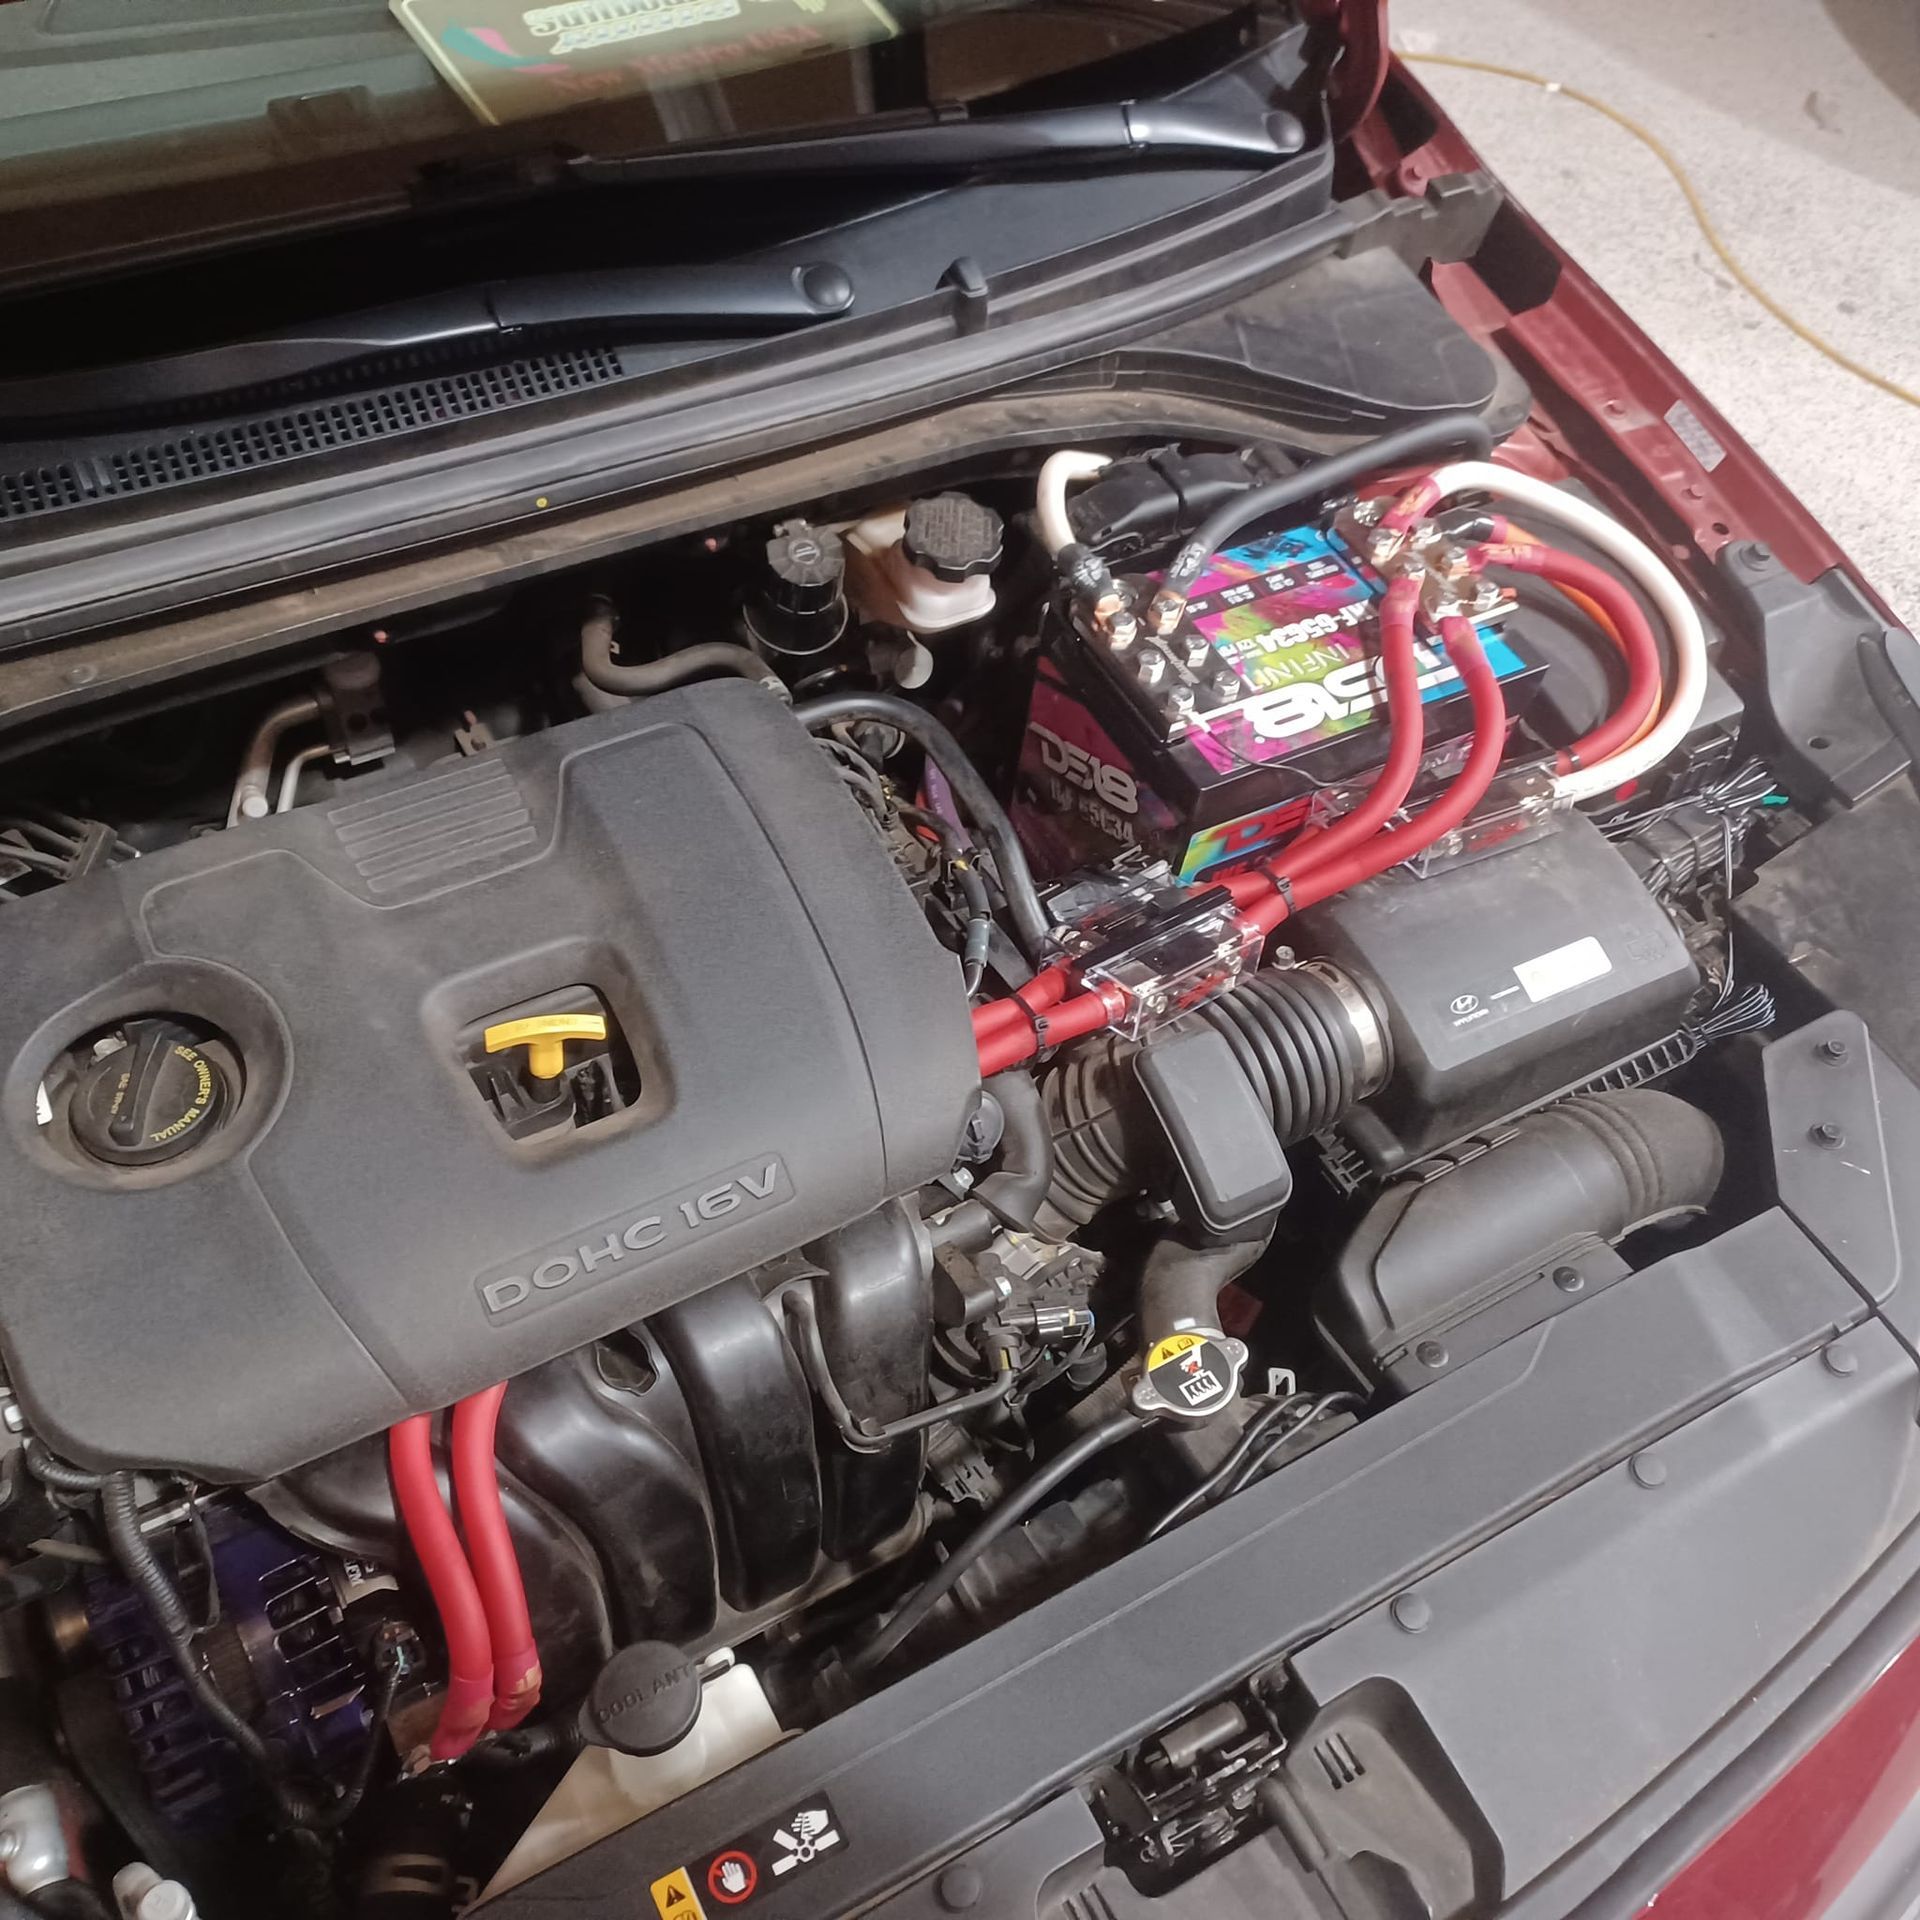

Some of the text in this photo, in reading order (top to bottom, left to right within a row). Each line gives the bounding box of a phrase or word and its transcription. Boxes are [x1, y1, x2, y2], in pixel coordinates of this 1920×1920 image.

[1240, 643, 1350, 692] INFINIT
[1028, 721, 1138, 814] DS18
[149, 1045, 212, 1142] SEE OWNER'S MANUAL
[482, 1162, 778, 1314] DOHC 16V
[599, 1662, 691, 1725] COOLANT
